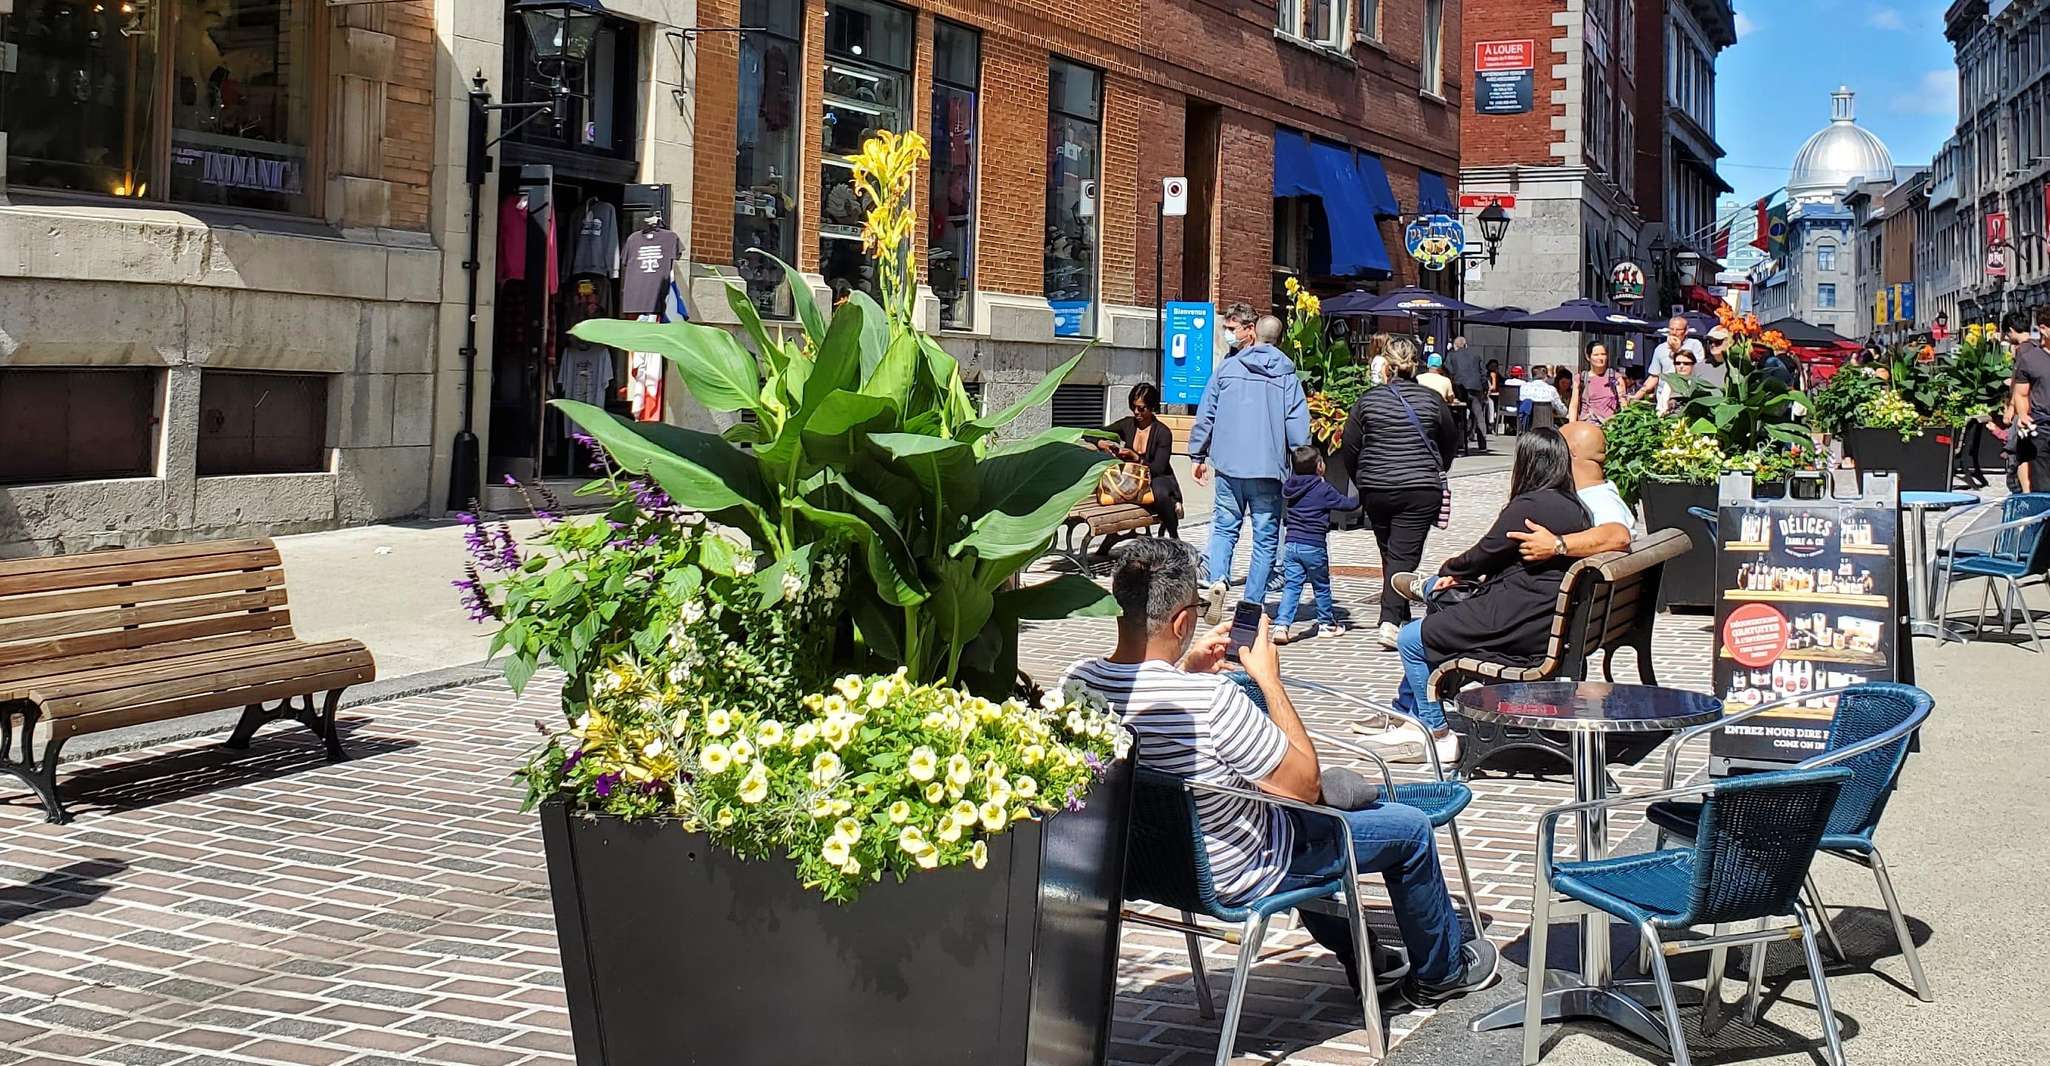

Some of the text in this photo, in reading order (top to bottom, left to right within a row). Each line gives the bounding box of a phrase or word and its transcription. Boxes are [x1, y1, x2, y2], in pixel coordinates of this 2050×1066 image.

[1493, 44, 1524, 54] LOUER
[1173, 308, 1207, 316] Bienvenue
[1724, 725, 1764, 736] ENTREZ
[1766, 727, 1796, 737] NOUS
[1797, 729, 1822, 739] DIRE
[1773, 739, 1799, 749] COME
[1800, 741, 1814, 750] ON
